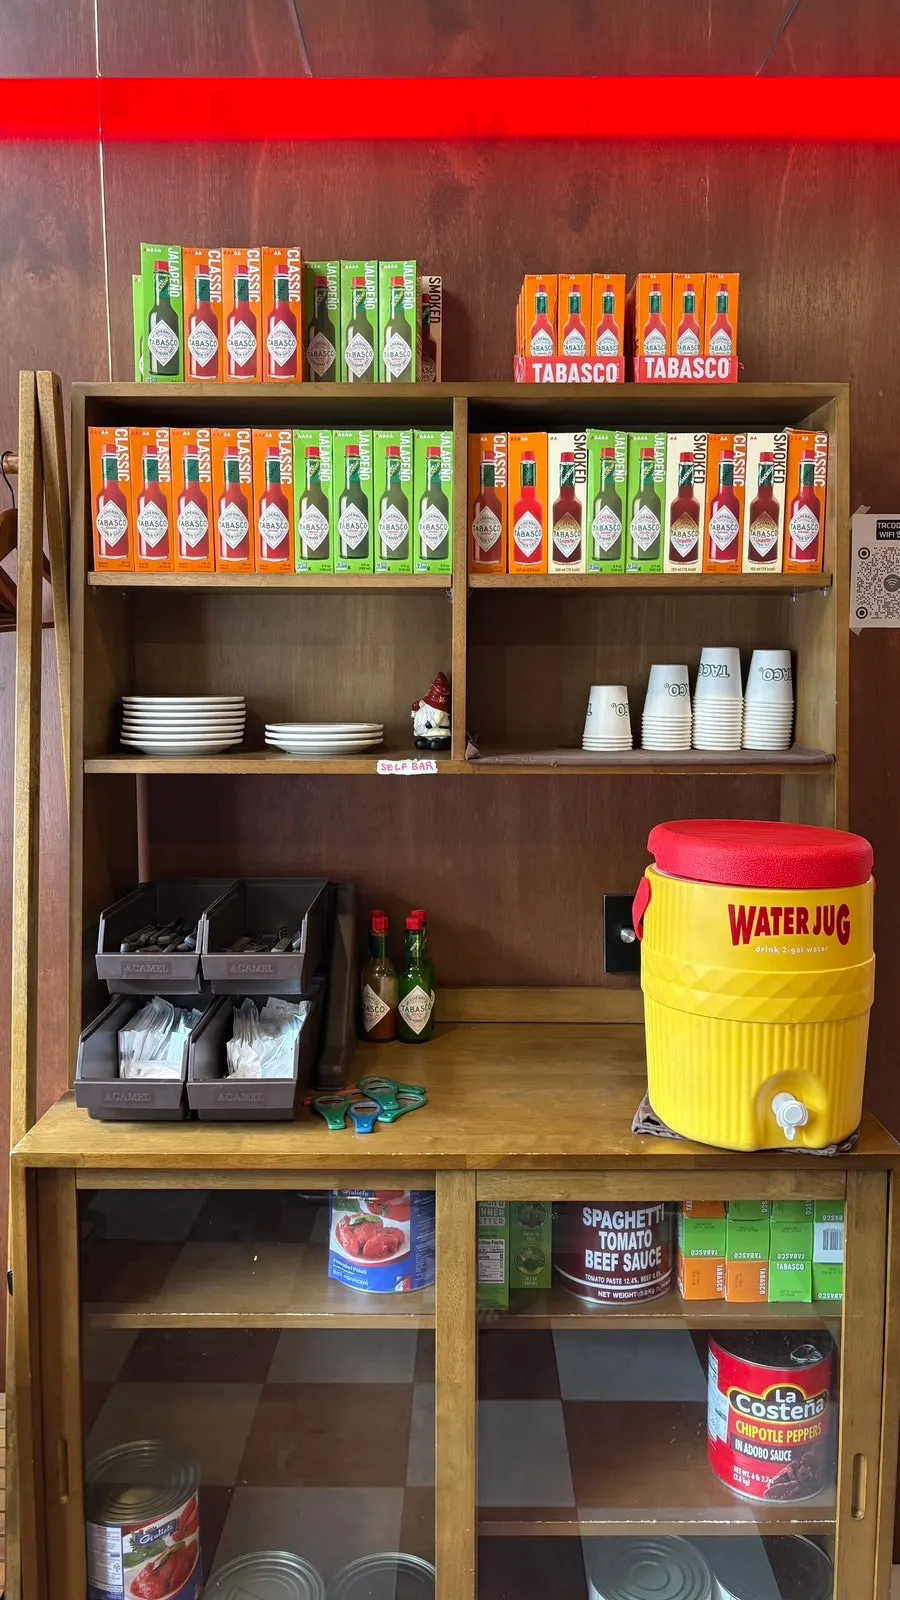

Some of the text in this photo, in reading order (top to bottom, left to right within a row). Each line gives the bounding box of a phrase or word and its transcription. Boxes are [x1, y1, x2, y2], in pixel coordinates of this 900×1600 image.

[208, 249, 222, 303] CLASSIC
[246, 248, 260, 303] CLASSIC
[287, 249, 301, 303] CLASSIC
[428, 276, 442, 324] SMOKED
[149, 339, 177, 347] TABASCO
[189, 339, 217, 347] TABASCO
[227, 339, 256, 347] TABASCO
[267, 339, 296, 347] TABASCO
[532, 363, 617, 383] TABASCO
[644, 357, 729, 379] TABASCO
[115, 428, 130, 482] CLASSIC
[155, 429, 171, 483] CLASSIC
[196, 429, 211, 483] CLASSIC
[236, 430, 251, 484] CLASSIC
[278, 431, 292, 485] CLASSIC
[573, 434, 587, 484] SMOKED
[693, 434, 706, 484] SMOKED
[773, 434, 786, 484] SMOKED
[493, 435, 506, 488] CLASSIC
[733, 435, 746, 487] CLASSIC
[814, 434, 827, 487] CLASSIC
[97, 519, 127, 527] TABASCO
[138, 520, 167, 528] TABASCO
[178, 520, 208, 528] TABASCO
[219, 521, 248, 529] TABASCO
[259, 522, 288, 530] TABASCO
[299, 523, 328, 531] TABASCO
[339, 522, 368, 530] TABASCO
[379, 523, 408, 531] TABASCO
[419, 523, 448, 531] TABASCO
[473, 524, 501, 532] TABASCO
[592, 524, 621, 532] TABASCO
[631, 524, 660, 532] TABASCO
[710, 523, 738, 531] TABASCO
[790, 523, 819, 531] TABASCO
[514, 530, 543, 538] TABASCO
[554, 530, 581, 538] TABASCO
[671, 529, 698, 538] TABASCO
[750, 529, 778, 538] TABASCO
[411, 761, 434, 771] BAR
[728, 903, 851, 946] WATER JUG
[755, 945, 779, 953] drink
[782, 946, 804, 955] 2-gal
[363, 1005, 385, 1013] ASCO
[402, 1004, 431, 1014] TABASCO
[582, 1203, 665, 1230] SPAGHETTI
[599, 1229, 653, 1251] TOMATO
[585, 1246, 662, 1272] BEEF SAUCE
[777, 1263, 804, 1271] TABASCO
[585, 1273, 605, 1283] TOMATO
[606, 1277, 622, 1285] PASTE
[598, 1290, 611, 1298] NET
[775, 1389, 797, 1404] La
[735, 1394, 824, 1421] Costeña
[735, 1419, 822, 1443] CHIPOTLE PEPPERS
[735, 1438, 792, 1462] IN ADOBO SAUCE
[733, 1465, 742, 1474] NET
